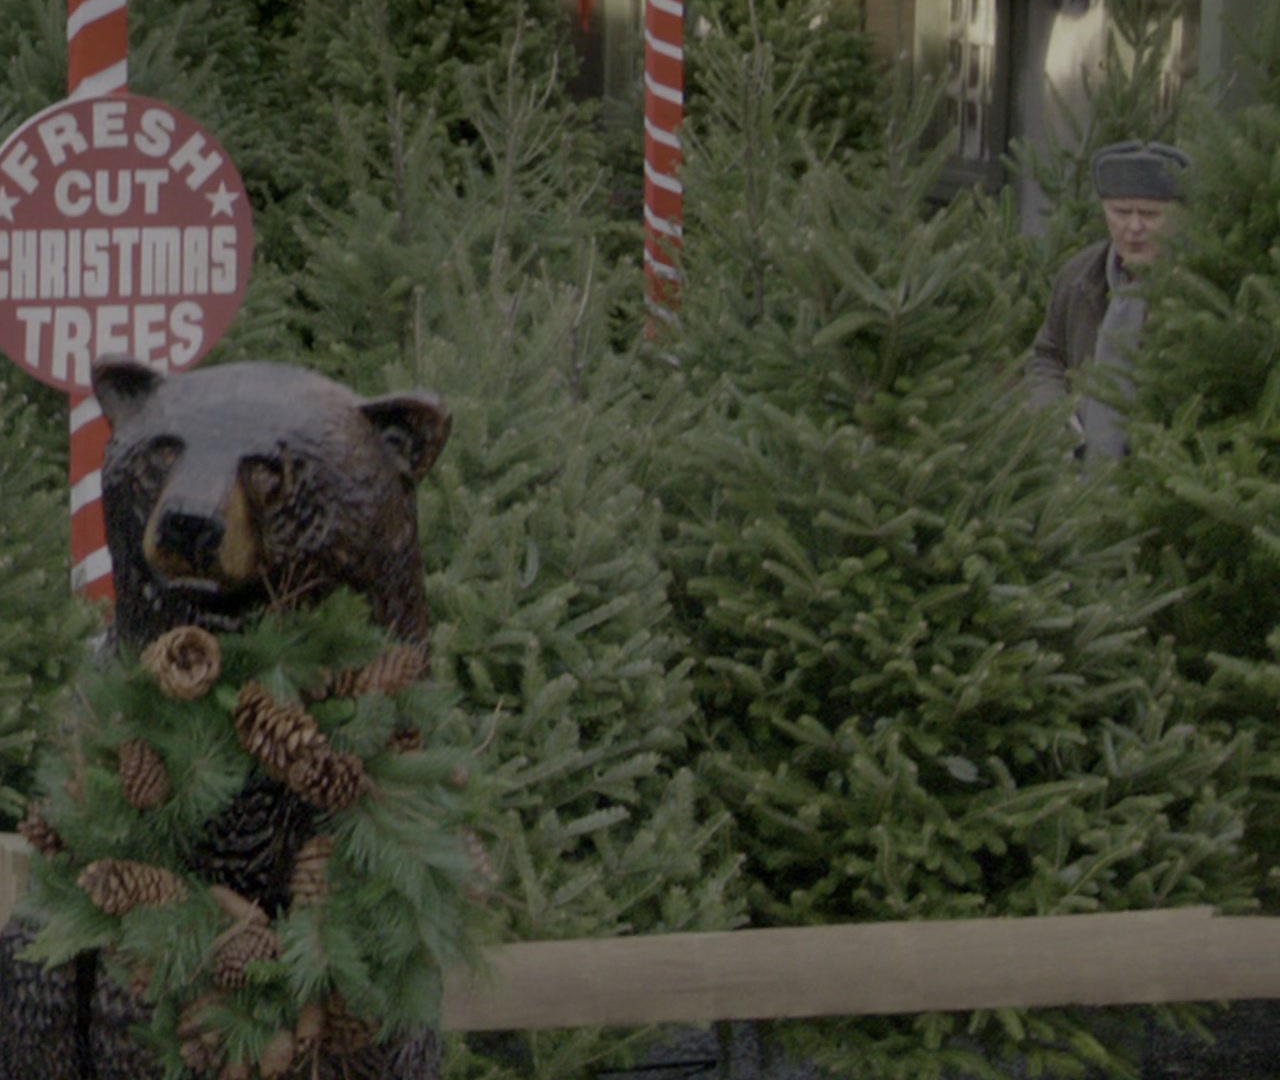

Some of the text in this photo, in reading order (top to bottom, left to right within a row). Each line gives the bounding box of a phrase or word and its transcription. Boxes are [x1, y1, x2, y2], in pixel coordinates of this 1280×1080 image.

[0, 100, 223, 195] FRESH
[54, 168, 170, 217] CUT
[16, 300, 204, 387] TREES
